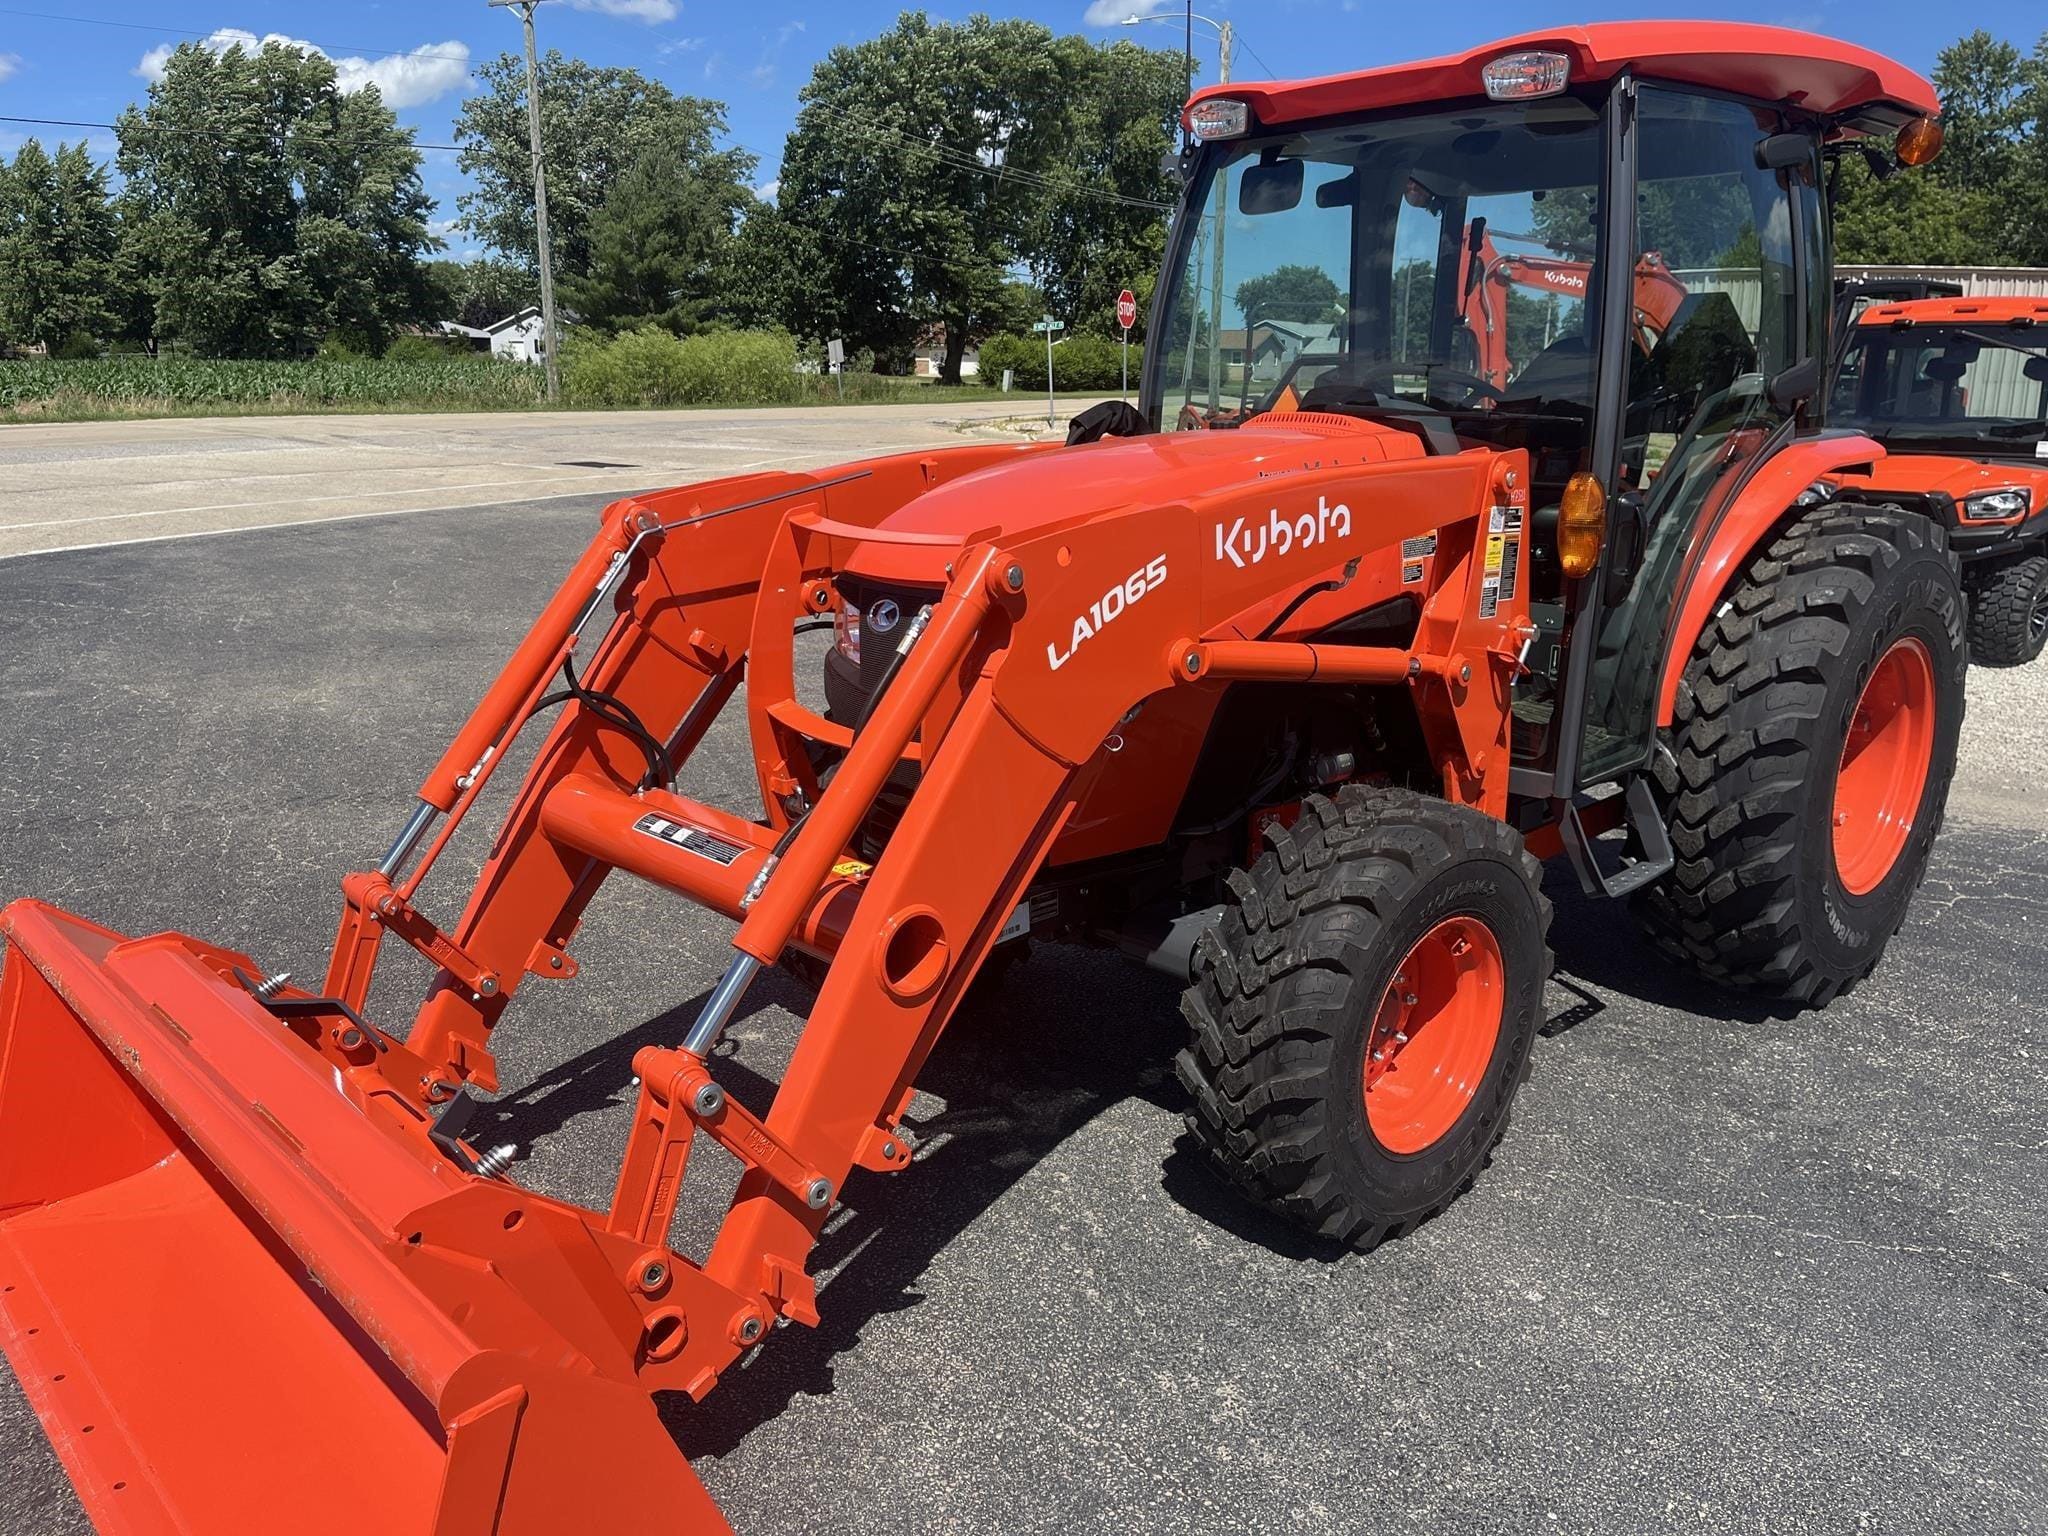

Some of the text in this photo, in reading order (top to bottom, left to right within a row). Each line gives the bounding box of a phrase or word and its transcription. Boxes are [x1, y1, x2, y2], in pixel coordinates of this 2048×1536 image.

[1544, 270, 1584, 288] Kubota
[1119, 301, 1135, 317] STOP
[1215, 496, 1351, 569] Kubota
[1046, 553, 1168, 671] LA1065
